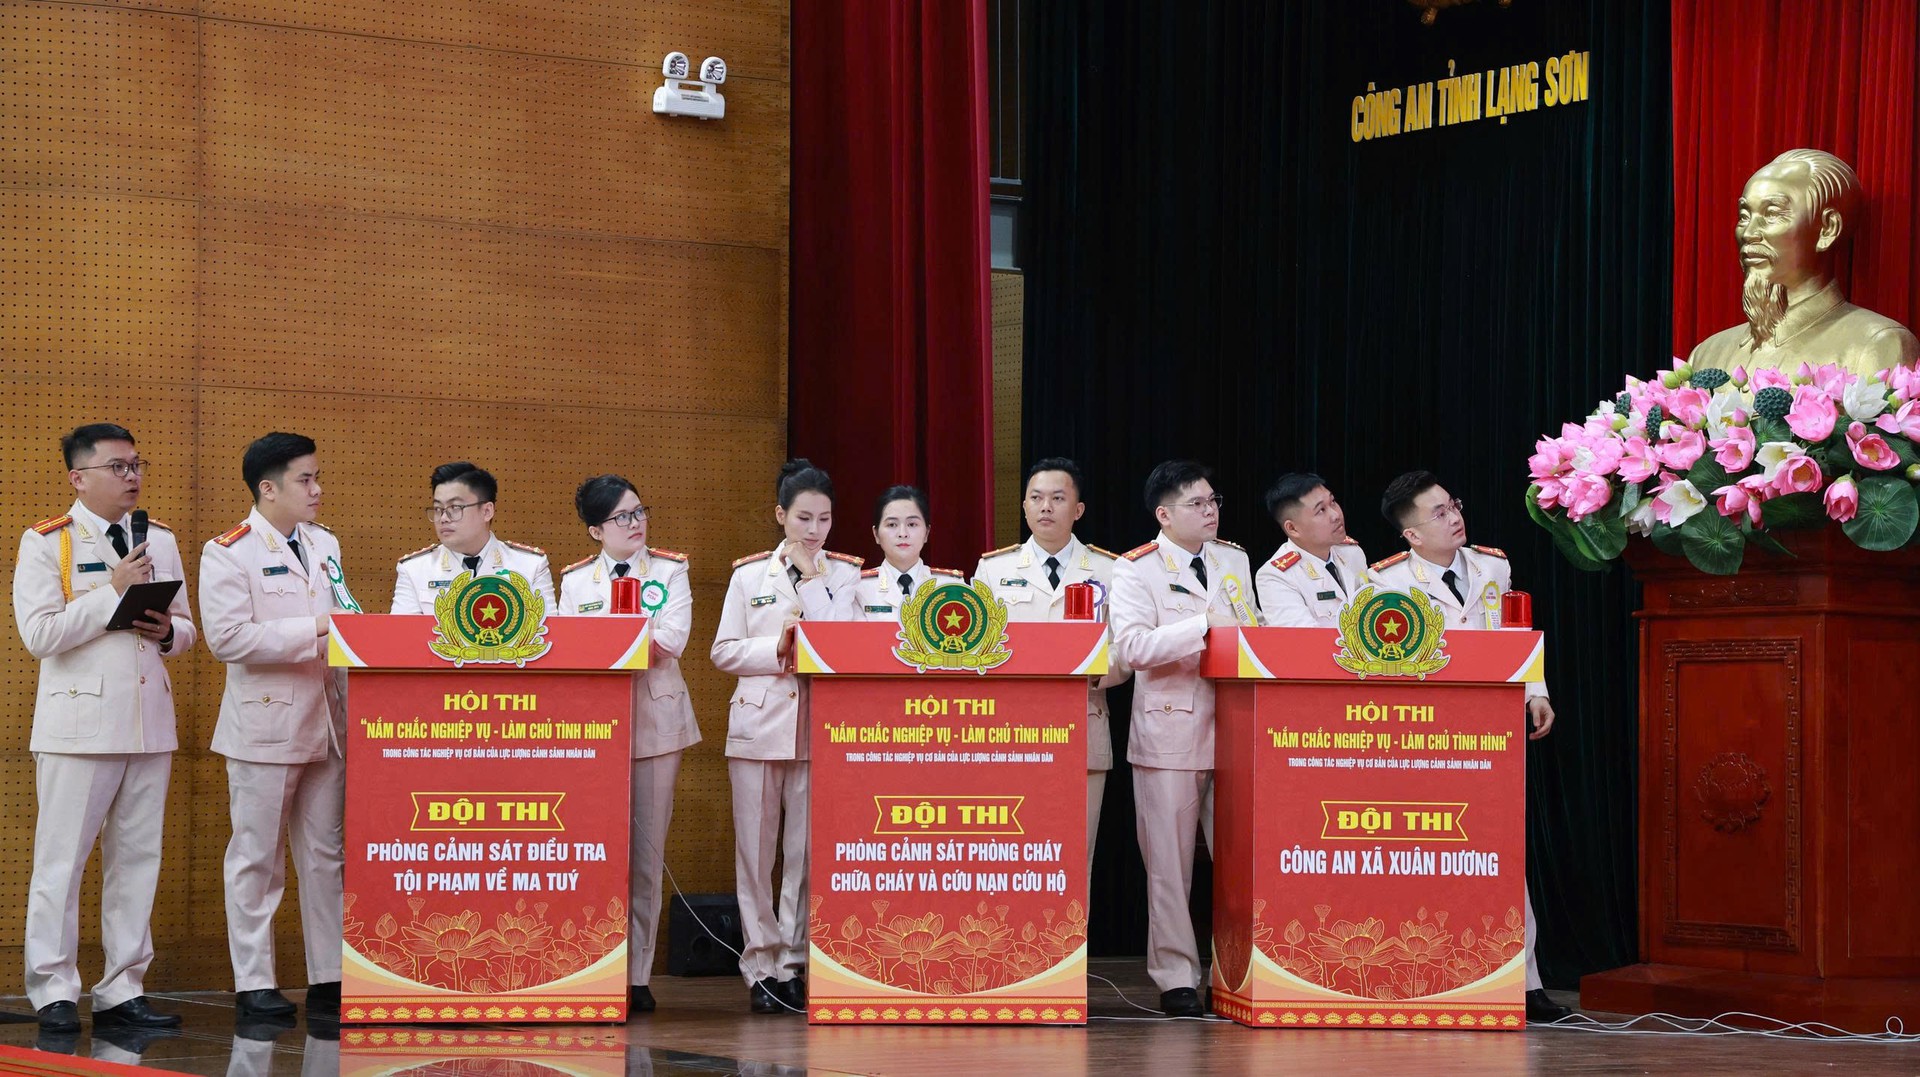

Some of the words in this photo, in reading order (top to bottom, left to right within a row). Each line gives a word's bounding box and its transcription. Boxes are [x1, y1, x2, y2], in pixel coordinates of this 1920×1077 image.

[1351, 81, 1401, 143] CÔNG
[1403, 81, 1433, 133] AN
[1437, 59, 1481, 127] TỈNH
[1485, 61, 1539, 125] LẠNG
[1544, 50, 1590, 107] SƠN
[444, 690, 488, 714] HỘI
[493, 694, 537, 711] THI
[905, 694, 948, 719] HỘI
[953, 698, 995, 715] THI
[1345, 701, 1388, 724] HỘI
[1393, 705, 1434, 722] THI
[397, 716, 428, 739] CHẮC
[431, 719, 473, 742] NGHIỆP
[476, 723, 491, 742] VỤ
[502, 719, 526, 739] LÀM
[529, 718, 552, 739] CHỦ
[555, 720, 581, 739] TÌNH
[860, 721, 890, 743] CHẮC
[892, 724, 934, 747] NGHIỆP
[936, 727, 951, 747] VỤ
[961, 724, 985, 744] LÀM
[988, 722, 1011, 744] CHỦ
[1013, 723, 1039, 744] TÌNH
[1302, 727, 1331, 748] CHẮC
[1334, 730, 1374, 752] NGHIỆP
[1377, 733, 1391, 752] VỤ
[1401, 730, 1424, 750] LÀM
[1427, 729, 1449, 750] CHỦ
[1452, 731, 1477, 750] TÌNH
[428, 798, 485, 825] ĐỘI
[497, 802, 548, 821] THI
[890, 802, 946, 828] ĐỘI
[958, 806, 1008, 824] THI
[1337, 807, 1392, 834] ĐỘI
[1402, 812, 1452, 831] THI
[366, 838, 428, 861] PHÒNG
[434, 837, 483, 861] CẢNH
[489, 839, 523, 861] SÁT
[527, 837, 569, 861] ĐIỀU
[573, 843, 607, 861] TRA
[835, 839, 887, 861] PHÒNG
[891, 837, 932, 861] CẢNH
[936, 839, 965, 861] SÁT
[968, 839, 1019, 861] PHÒNG
[1023, 839, 1062, 861] CHÁY
[1280, 845, 1327, 874] CÔNG
[1332, 850, 1356, 874] AN
[1361, 846, 1384, 875] XÃ
[1388, 846, 1435, 875] XUÂN
[1440, 849, 1499, 877] DƯƠNG
[393, 869, 421, 895] TỘI
[427, 873, 480, 895] PHẠM
[485, 867, 507, 891] VỀ
[512, 873, 542, 891] MA
[546, 869, 579, 891] TUÝ
[831, 869, 871, 892] CHỮA
[875, 869, 914, 892] CHÁY
[918, 869, 938, 892] VÀ
[942, 869, 972, 892] CỨU
[976, 873, 1008, 896] NẠN
[1012, 869, 1042, 892] CỨU
[1046, 869, 1067, 896] HỘ
